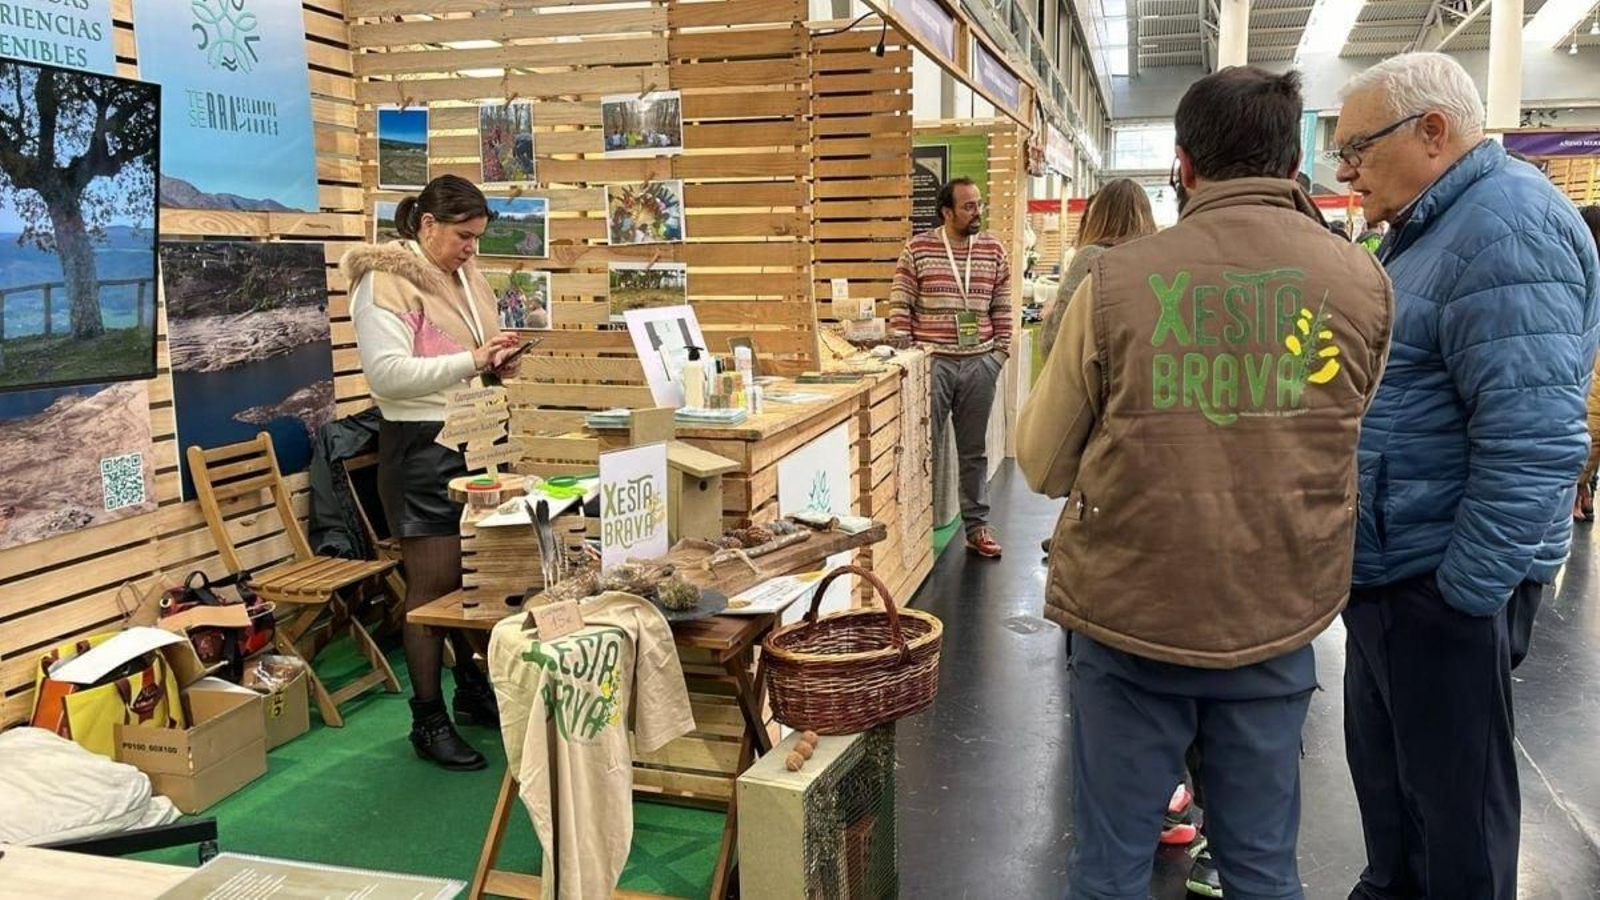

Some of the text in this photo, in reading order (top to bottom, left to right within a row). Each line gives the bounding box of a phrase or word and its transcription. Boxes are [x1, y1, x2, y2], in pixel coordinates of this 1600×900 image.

[0, 3, 102, 42] RIENCIAS
[0, 34, 87, 68] ENIBLES
[1149, 267, 1306, 347] XESTA
[1152, 352, 1303, 426] BRAVA
[603, 474, 654, 519] XESTA
[604, 512, 655, 549] BRAVA
